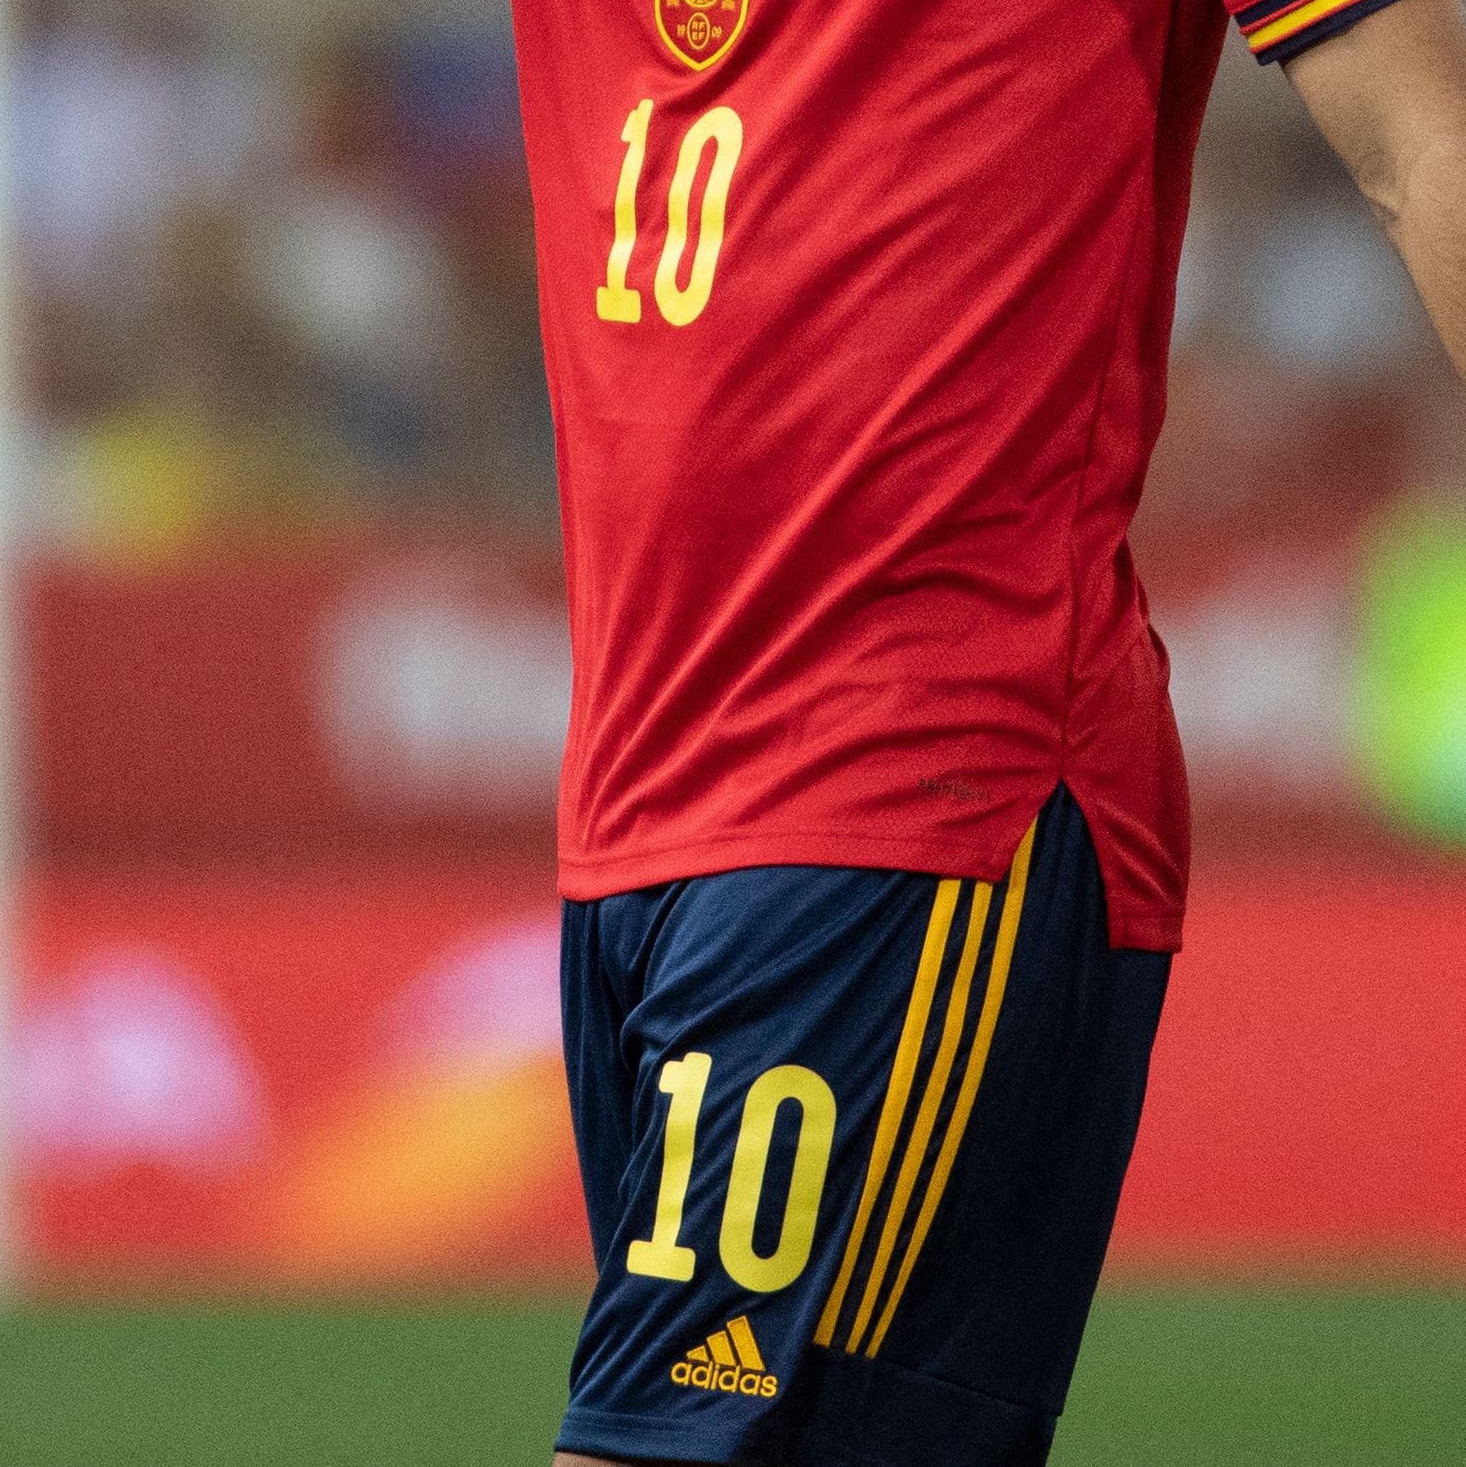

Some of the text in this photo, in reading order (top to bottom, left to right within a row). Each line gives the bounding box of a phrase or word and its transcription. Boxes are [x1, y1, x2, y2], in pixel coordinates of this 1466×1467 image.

[596, 98, 744, 327] 10
[626, 1051, 837, 1294] 10
[670, 1360, 779, 1399] adidas
